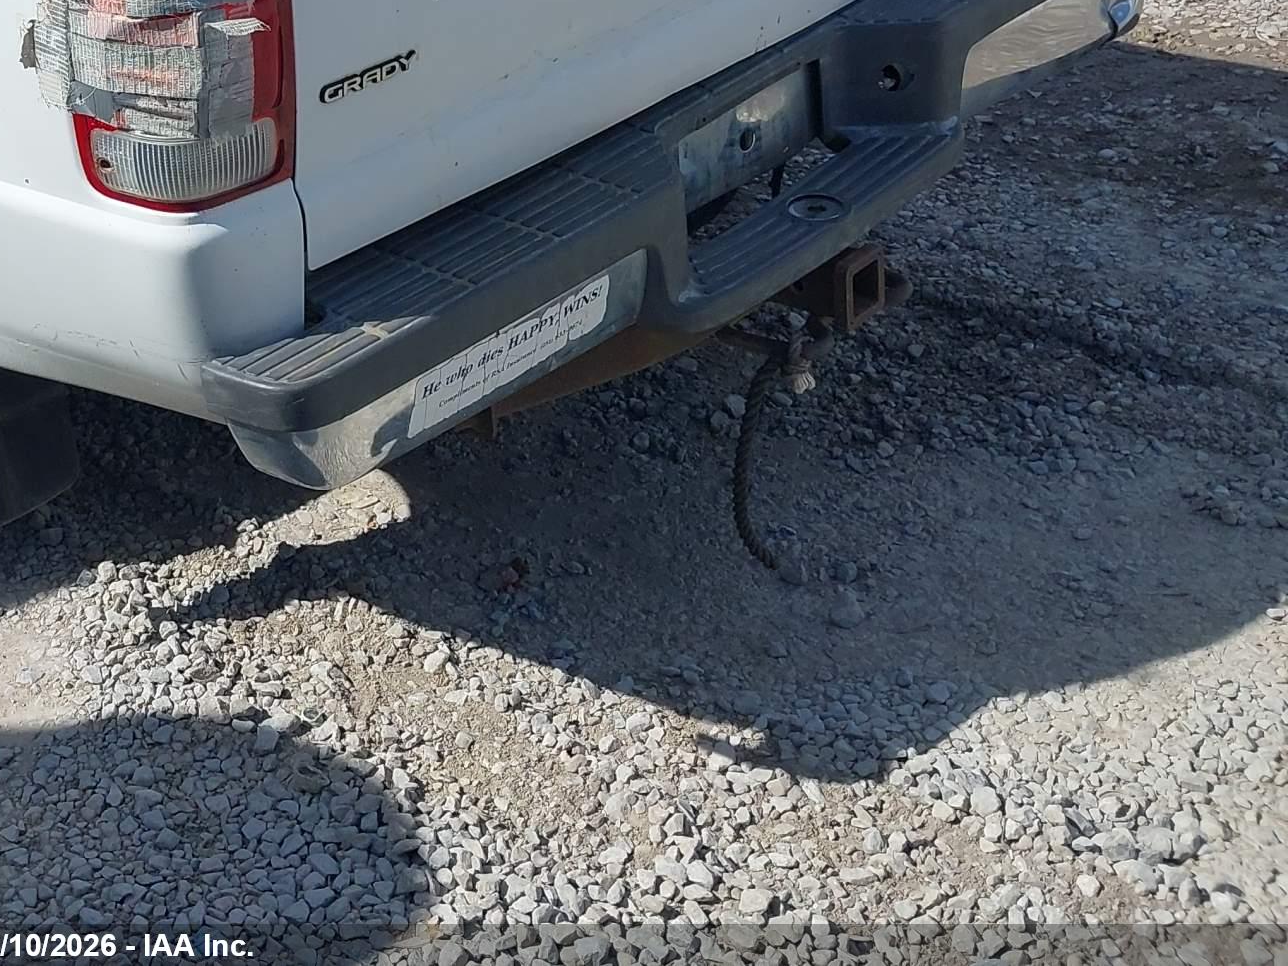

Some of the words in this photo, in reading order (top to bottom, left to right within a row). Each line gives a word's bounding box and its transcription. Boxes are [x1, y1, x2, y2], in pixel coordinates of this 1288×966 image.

[319, 49, 416, 104] GRADY
[421, 380, 442, 400] He
[445, 363, 474, 386] who
[477, 346, 504, 368] dies
[564, 284, 603, 317] WINS!
